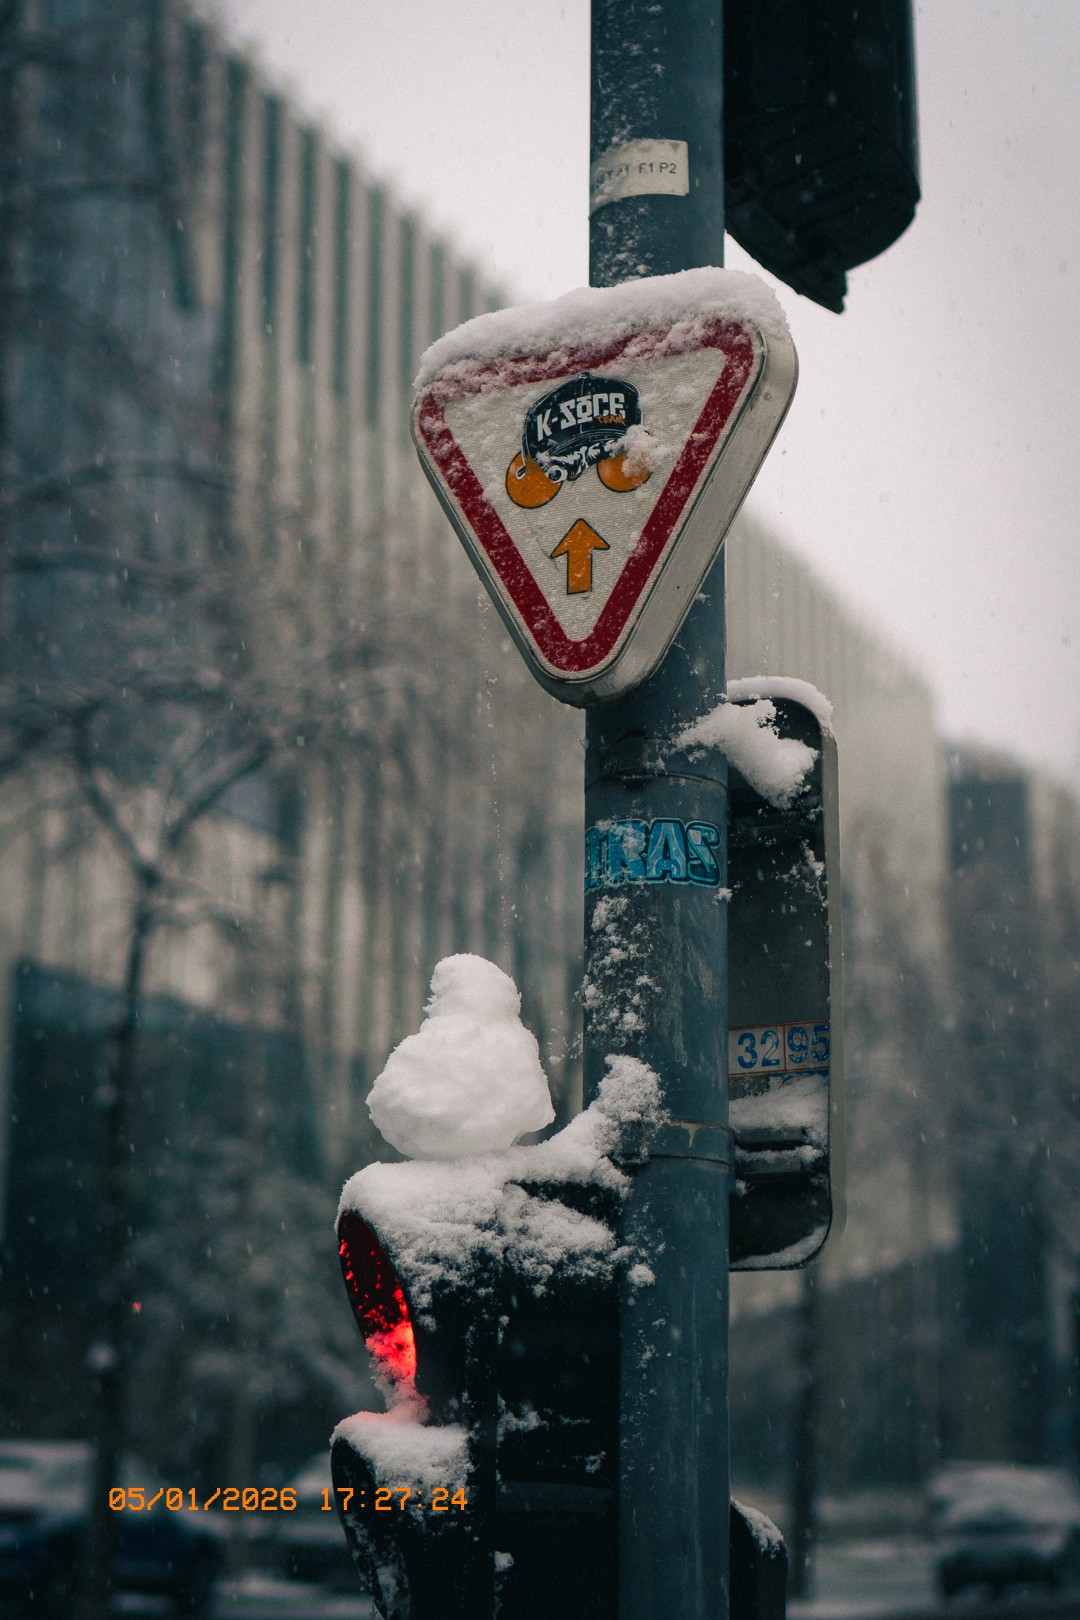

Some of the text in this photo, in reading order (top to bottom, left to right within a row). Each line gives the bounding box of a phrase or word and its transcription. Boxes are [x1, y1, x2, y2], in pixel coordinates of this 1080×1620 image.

[638, 162, 654, 174] F1
[660, 162, 677, 174] P2
[596, 413, 627, 427] TEAM
